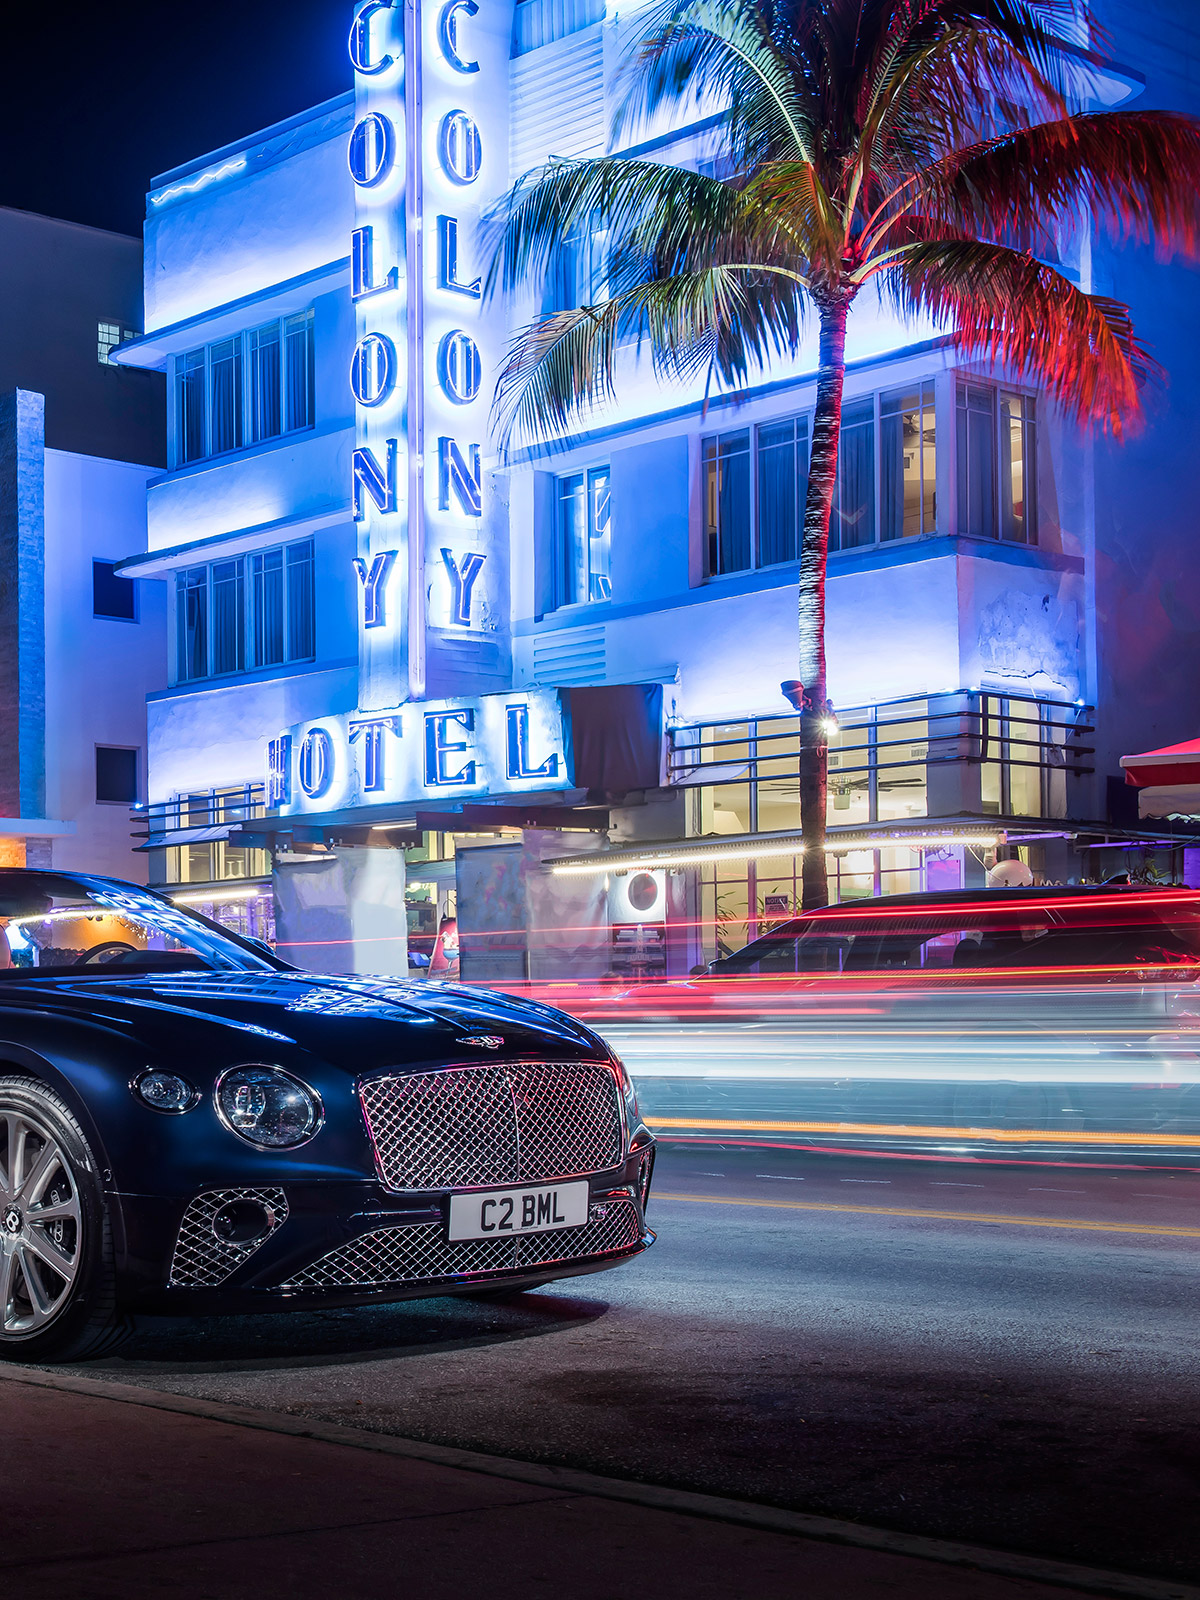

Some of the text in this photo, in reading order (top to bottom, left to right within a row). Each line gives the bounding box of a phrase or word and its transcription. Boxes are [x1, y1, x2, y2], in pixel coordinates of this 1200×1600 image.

[348, 0, 399, 629] COLONY
[436, 0, 487, 627] COLONY
[264, 703, 559, 810] HOTEL
[481, 1192, 565, 1231] C2 BML
